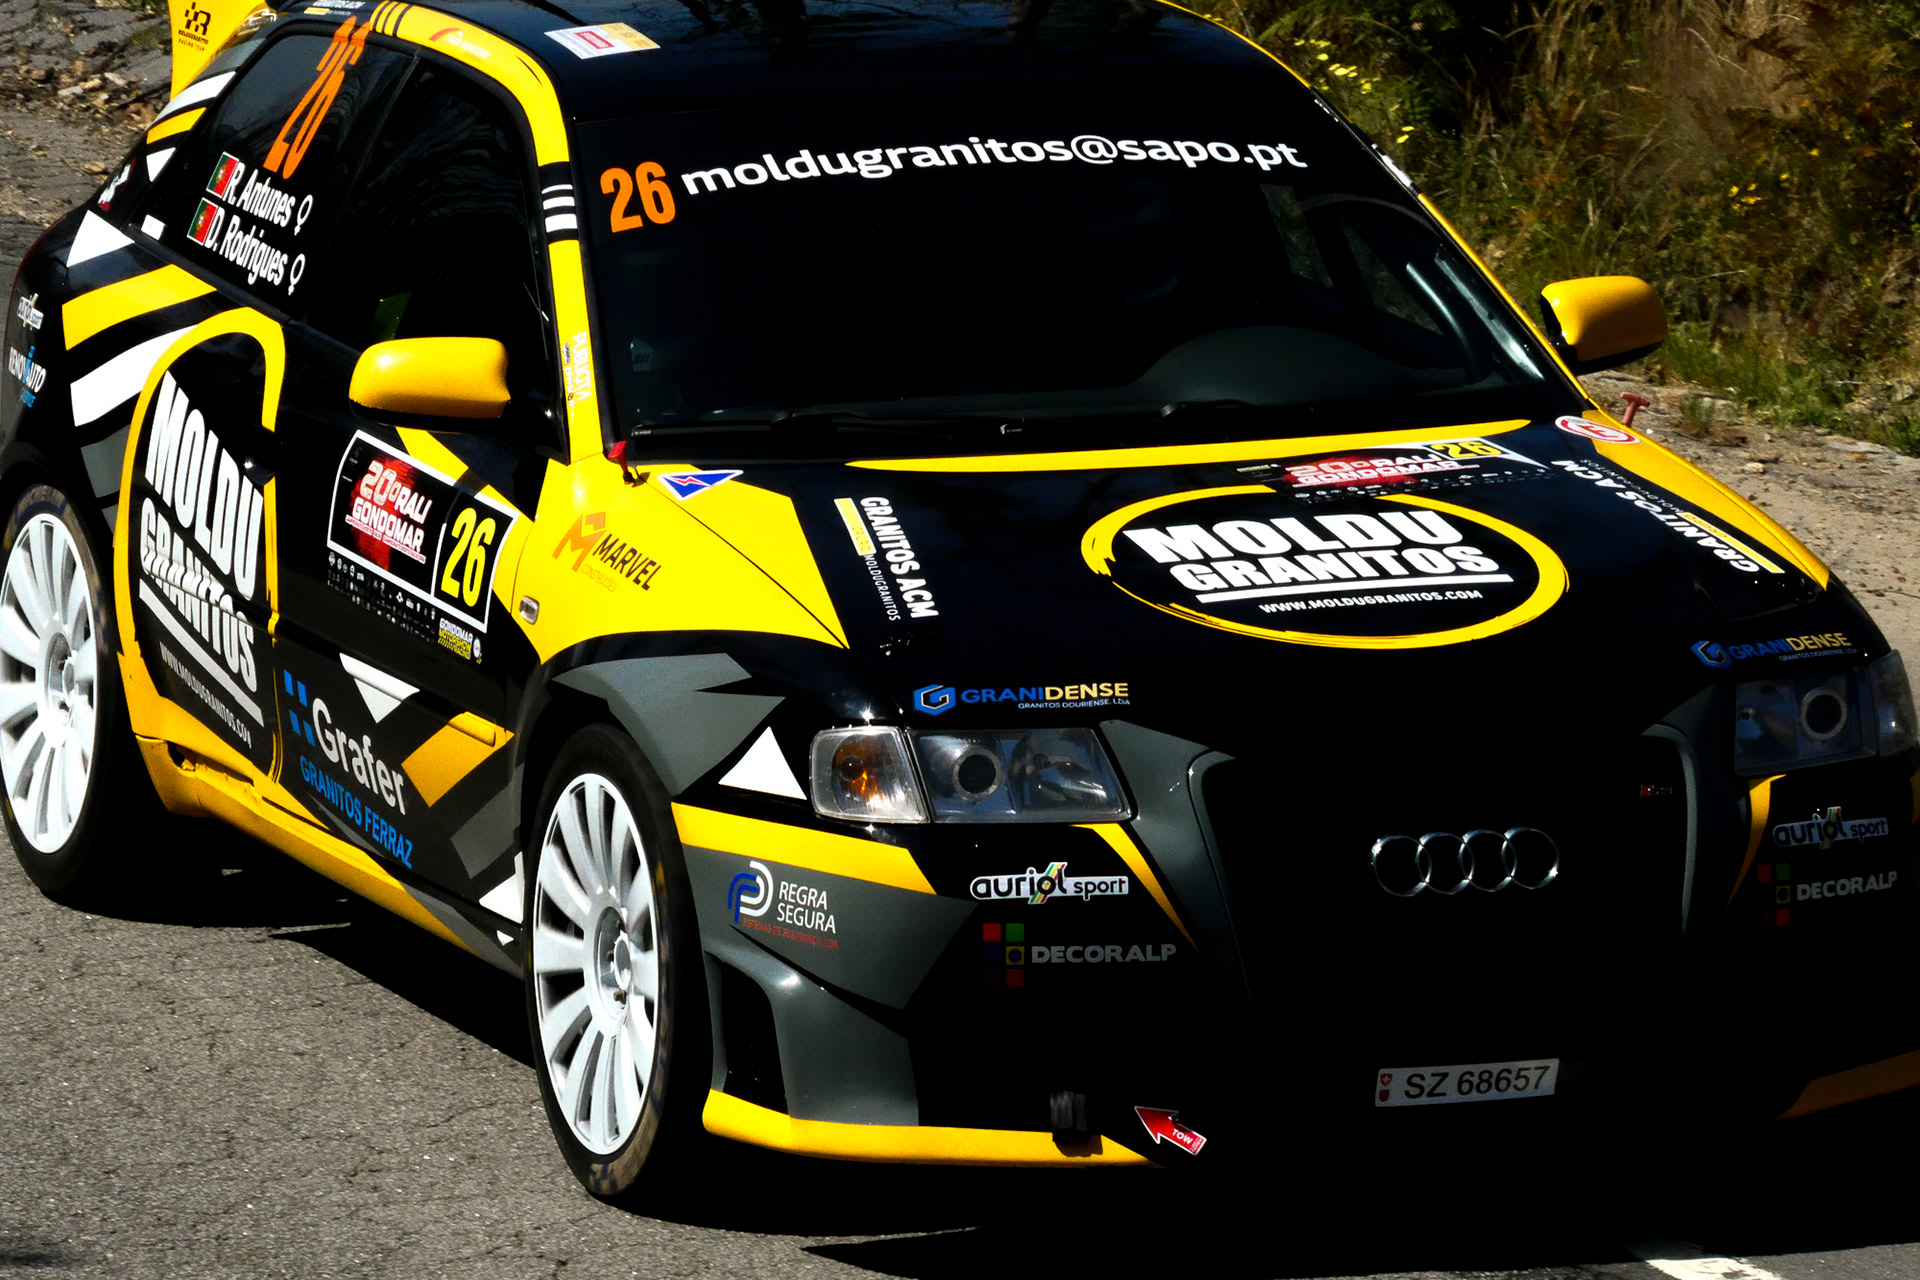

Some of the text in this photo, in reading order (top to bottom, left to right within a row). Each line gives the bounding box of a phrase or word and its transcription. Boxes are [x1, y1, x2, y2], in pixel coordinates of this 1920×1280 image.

[263, 16, 371, 180] 26
[681, 134, 1308, 195] moldugranitos@sapo.pt
[222, 161, 296, 228] R. Antunes
[600, 161, 675, 233] 26
[204, 206, 289, 285] D. Rodrigues
[1369, 453, 1443, 467] RALI
[1431, 441, 1503, 458] 26
[144, 369, 264, 600] MOLDU
[1297, 460, 1463, 485] GONDOMAR
[1550, 459, 1627, 489] ACM
[394, 487, 433, 524] RALI
[352, 496, 426, 553] GONDOMAR
[1123, 510, 1464, 564] MOLDU
[1615, 491, 1760, 573] GRANITOS
[440, 507, 497, 607] 26
[592, 532, 662, 592] MARVEL
[860, 496, 940, 618] GRANITOS ACM
[1169, 545, 1500, 592] GRANITOS
[140, 497, 258, 692] GRANITOS
[863, 553, 901, 621] MOLDUGRANITOS
[1259, 590, 1483, 614] WWW.MOLDUGRANITOS.COM
[439, 617, 474, 643] GONDOMAR
[1727, 632, 1852, 660] GRANIDENSE
[961, 682, 1129, 704] GRANIDENSE
[1017, 701, 1061, 710] GRANITOS
[312, 698, 406, 815] Grafer
[300, 755, 414, 869] GRANITOS FERRAZ
[1774, 812, 1887, 846] auriol sport
[778, 880, 828, 911] REGRA
[971, 867, 1127, 899] auriol sport
[1796, 870, 1897, 901] DECORALP
[776, 902, 836, 934] SEGURA
[1031, 944, 1177, 963] DECORALP
[1404, 1066, 1551, 1099] SZ 68657
[1172, 1128, 1194, 1145] TOW
